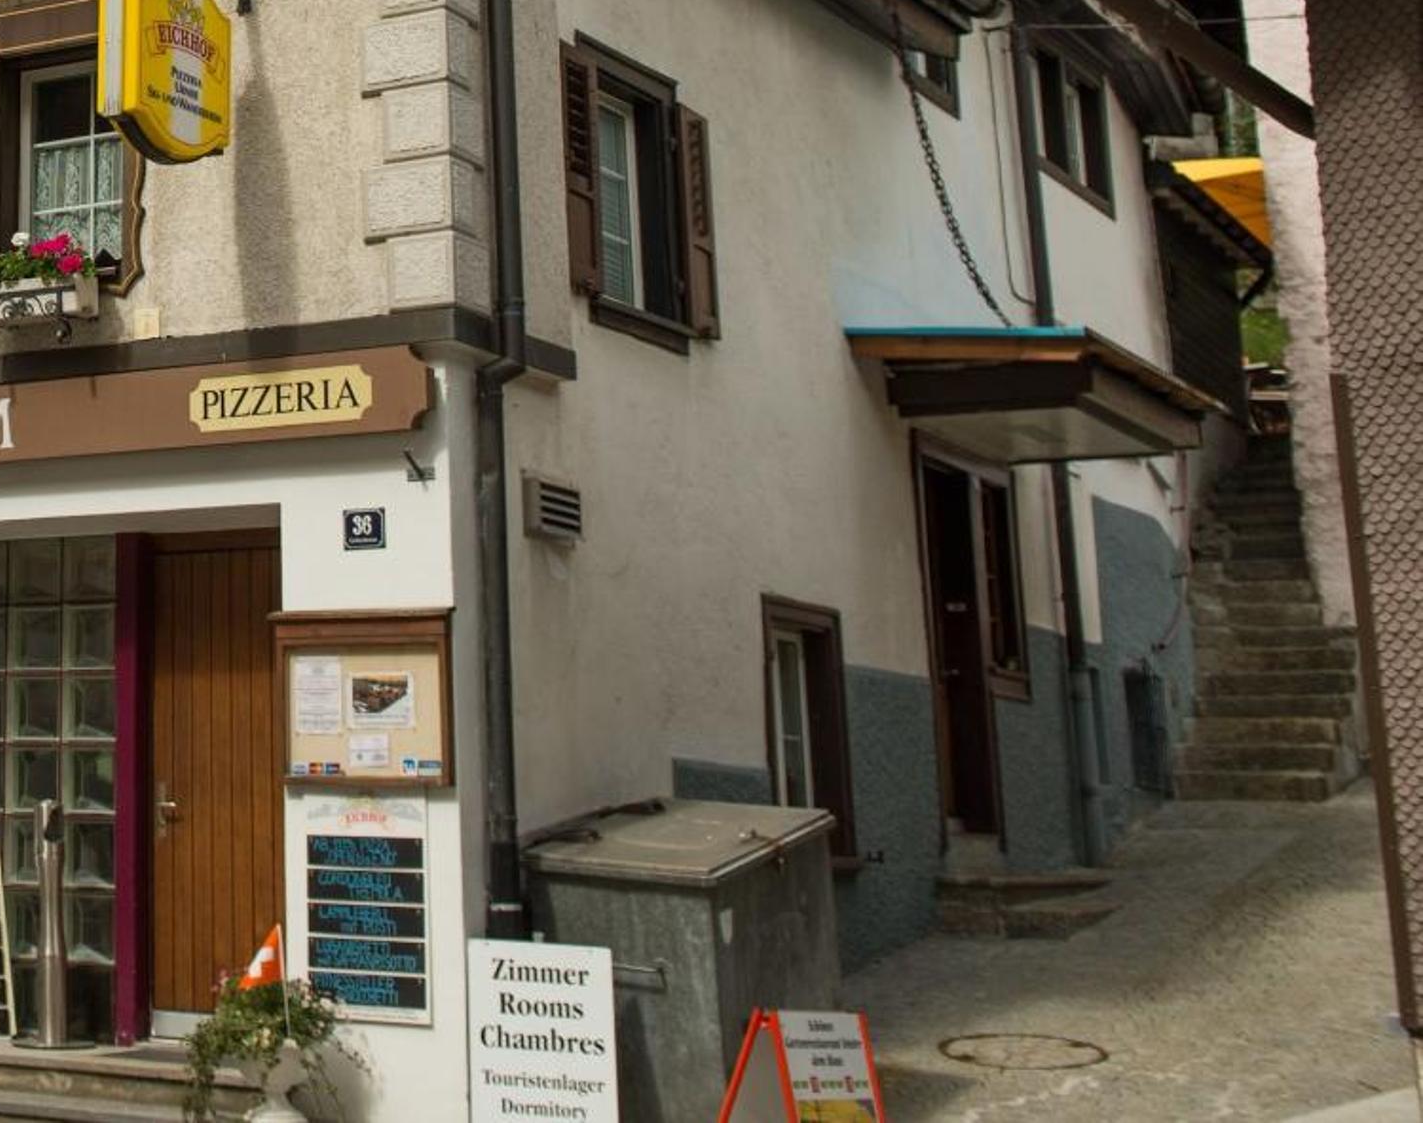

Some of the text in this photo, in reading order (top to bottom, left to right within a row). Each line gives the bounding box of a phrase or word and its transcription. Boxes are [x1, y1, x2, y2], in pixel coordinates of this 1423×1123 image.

[158, 24, 217, 63] EICHHOF
[202, 377, 360, 421] PIZZERIA
[492, 958, 590, 986] Zimmer
[499, 992, 584, 1020] Rooms
[480, 1025, 606, 1056] Chambres
[482, 1069, 606, 1097] Touristenlager
[501, 1097, 588, 1120] Dormitory
